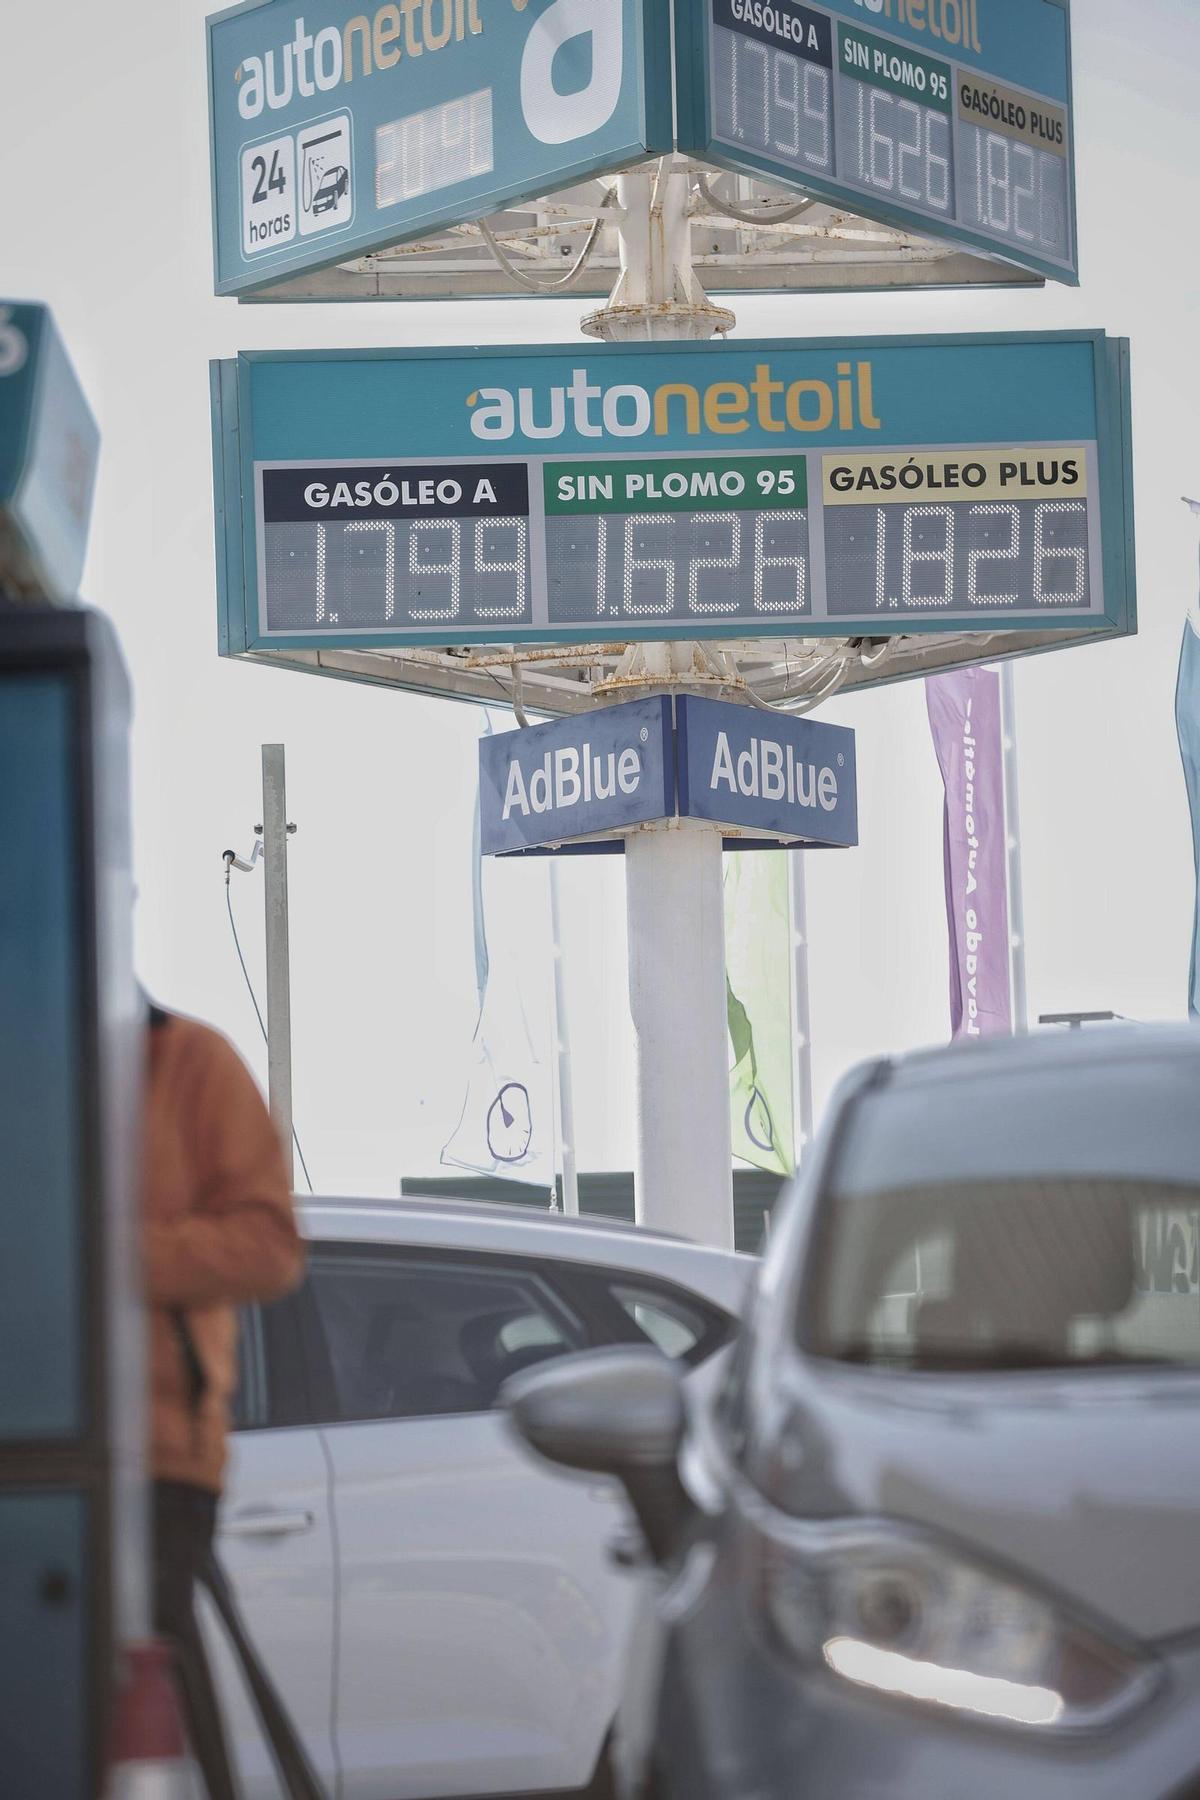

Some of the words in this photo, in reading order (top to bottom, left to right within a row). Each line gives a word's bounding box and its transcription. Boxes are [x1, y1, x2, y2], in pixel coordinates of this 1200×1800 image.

[730, 0, 803, 44] GASÓLEO
[807, 24, 819, 51] A
[844, 38, 870, 71] SIN
[873, 50, 926, 91] PLOMO
[929, 71, 948, 101] 95
[960, 84, 1027, 130] GASÓLEO
[1030, 111, 1064, 144] PLUS
[856, 81, 950, 210] 1.626
[251, 149, 287, 204] 24
[249, 212, 291, 244] horas
[466, 361, 881, 441] autonetoil
[303, 473, 463, 508] GASÓLEO
[472, 478, 498, 504] A
[556, 474, 613, 502] SIN
[626, 470, 746, 500] PLOMO
[756, 469, 796, 496] 95
[829, 457, 987, 492] GASÓLEO
[1000, 460, 1080, 487] PLUS
[315, 516, 526, 624] 1.799
[596, 509, 807, 615] 1.626
[875, 502, 1086, 609] 1.826
